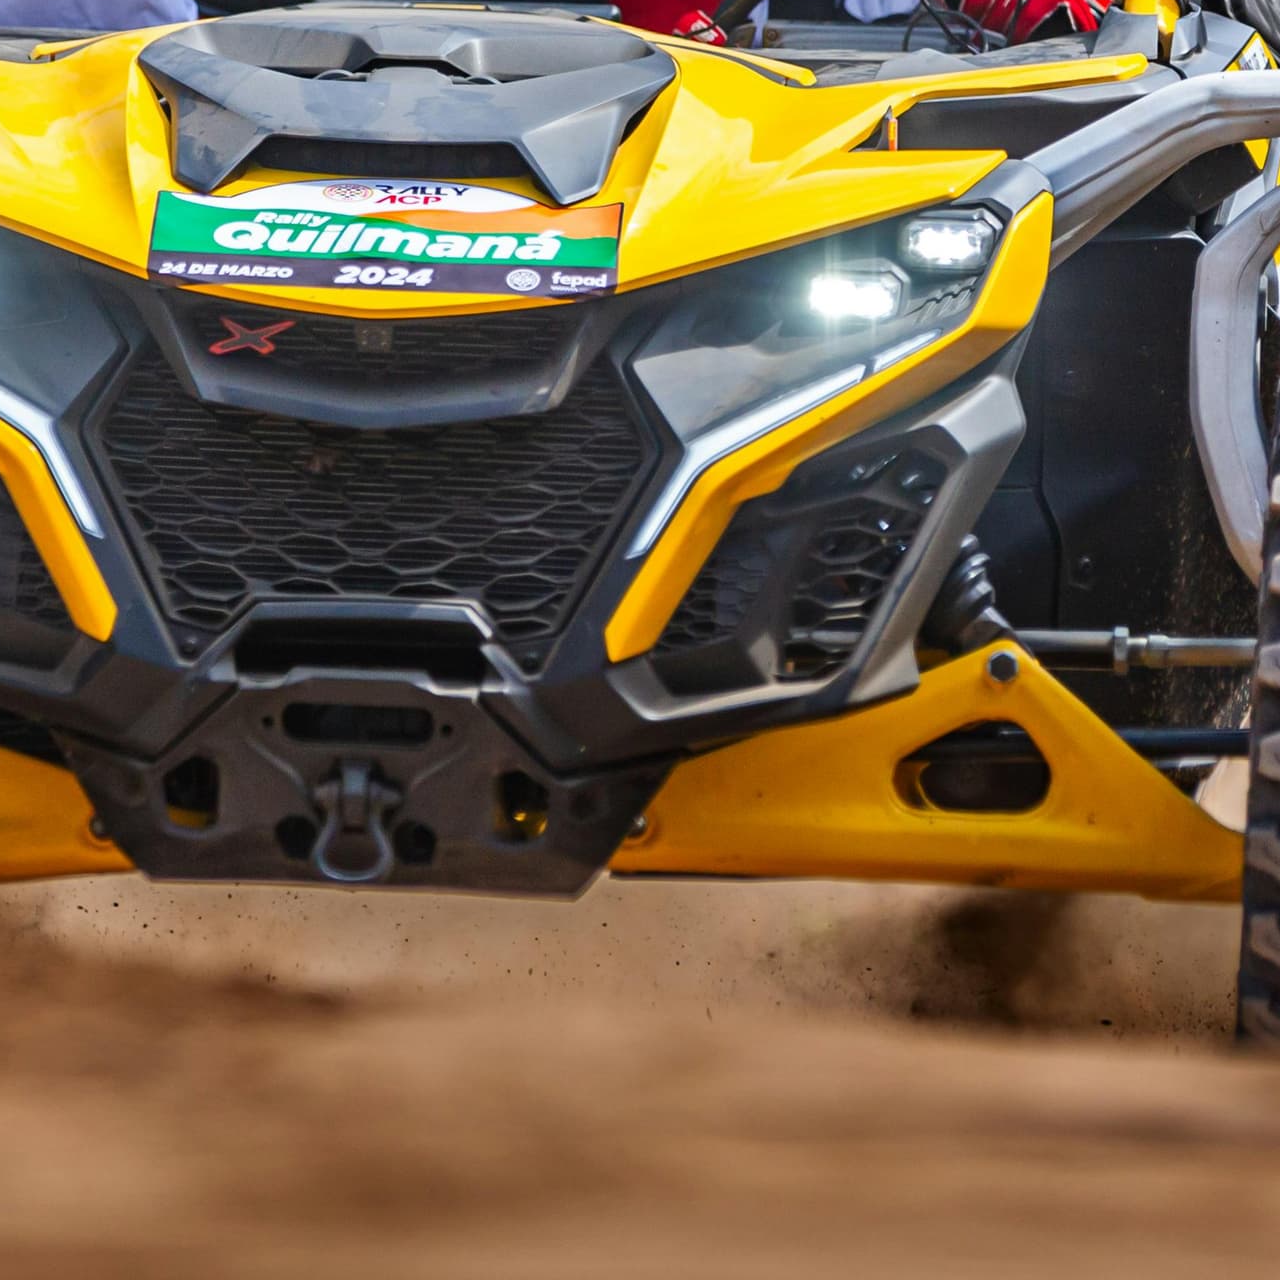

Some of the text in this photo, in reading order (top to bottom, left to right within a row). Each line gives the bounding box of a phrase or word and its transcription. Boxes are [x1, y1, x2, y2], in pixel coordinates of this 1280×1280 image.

[375, 184, 470, 196] RALLY
[375, 195, 442, 205] ACP
[254, 211, 332, 227] Rally
[213, 221, 565, 261] Quilmaná
[159, 262, 294, 278] 24 DE MARZO
[333, 266, 434, 286] 2024
